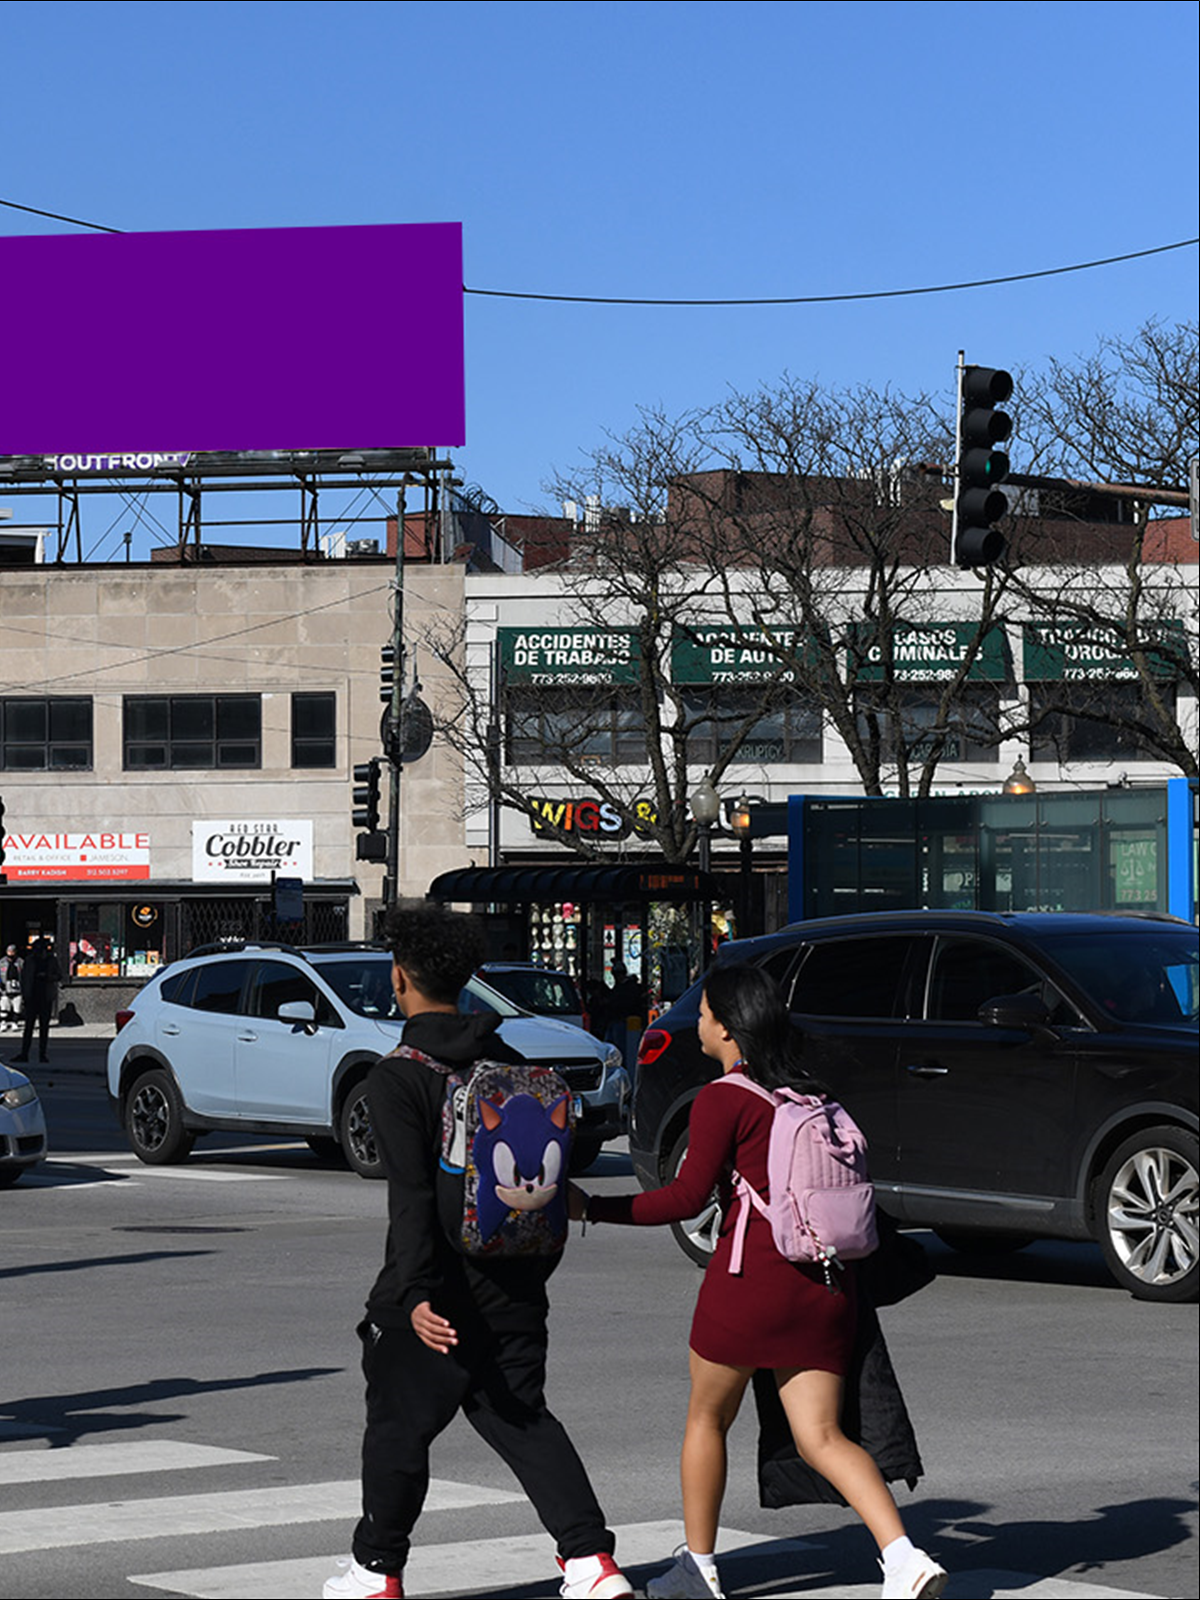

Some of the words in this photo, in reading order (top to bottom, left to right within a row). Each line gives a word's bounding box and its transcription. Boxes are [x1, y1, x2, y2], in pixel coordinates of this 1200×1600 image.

[514, 634, 631, 649] ACCIDENTES
[514, 651, 538, 665] DE
[711, 649, 735, 663] DE
[531, 801, 623, 832] WIGS
[2, 833, 150, 849] AVAILABLE
[205, 834, 301, 858] Cobbler
